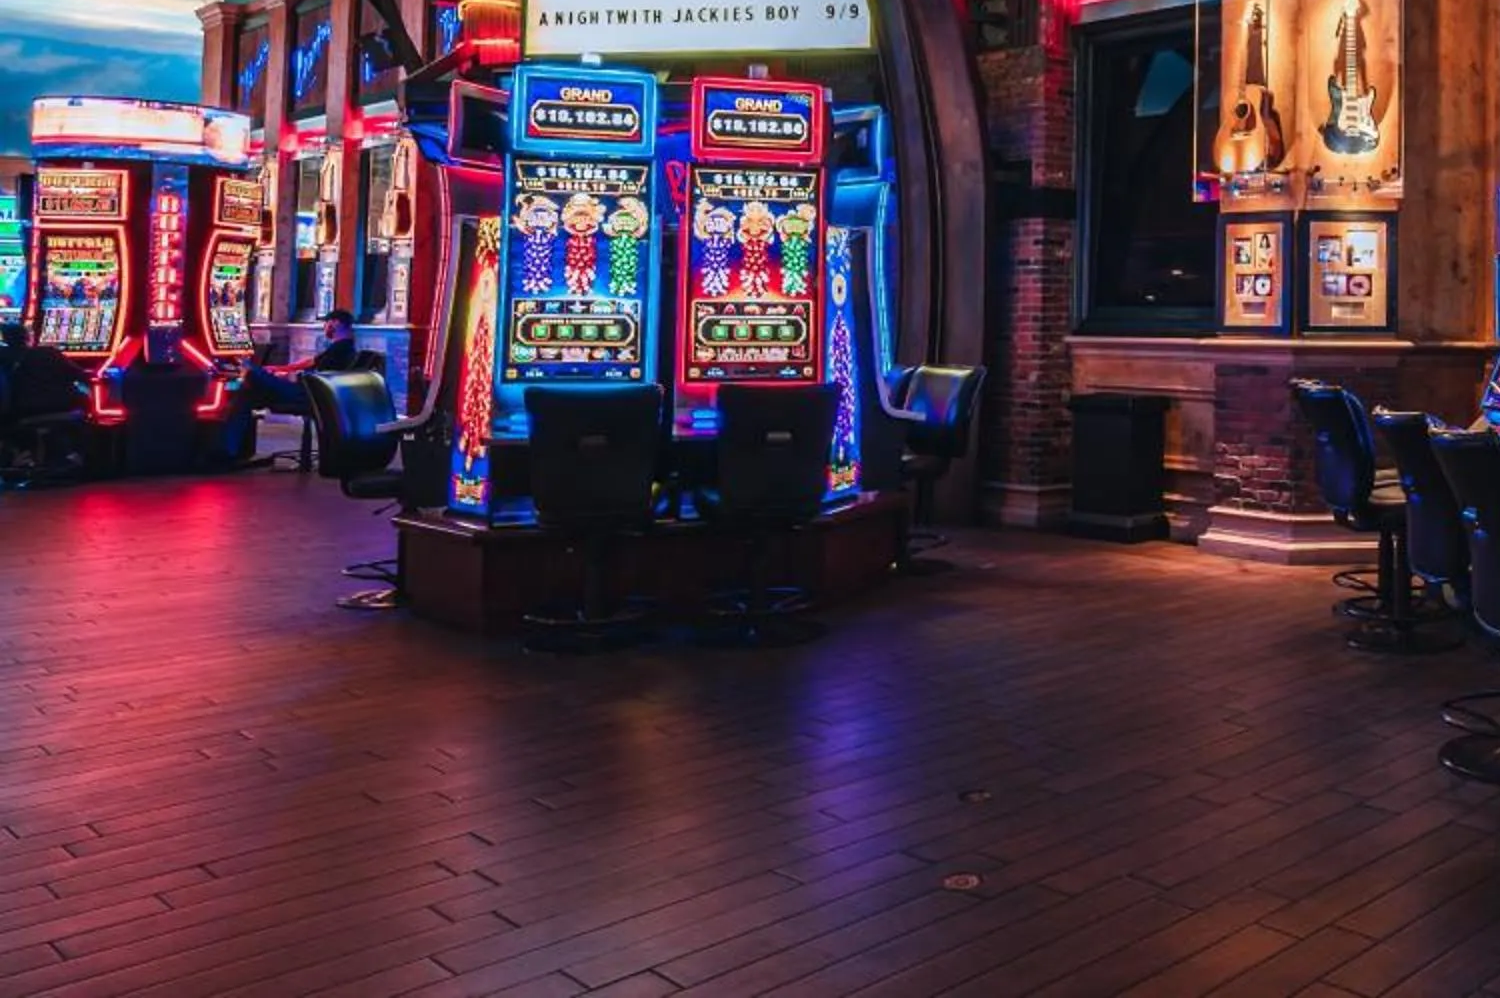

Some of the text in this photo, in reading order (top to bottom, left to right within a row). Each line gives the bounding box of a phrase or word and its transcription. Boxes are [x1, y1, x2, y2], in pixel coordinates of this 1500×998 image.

[673, 5, 756, 23] JACKIES
[765, 4, 801, 21] BOY
[825, 4, 860, 20] 9/9
[560, 87, 614, 103] GRAND
[735, 97, 783, 112] GRAND
